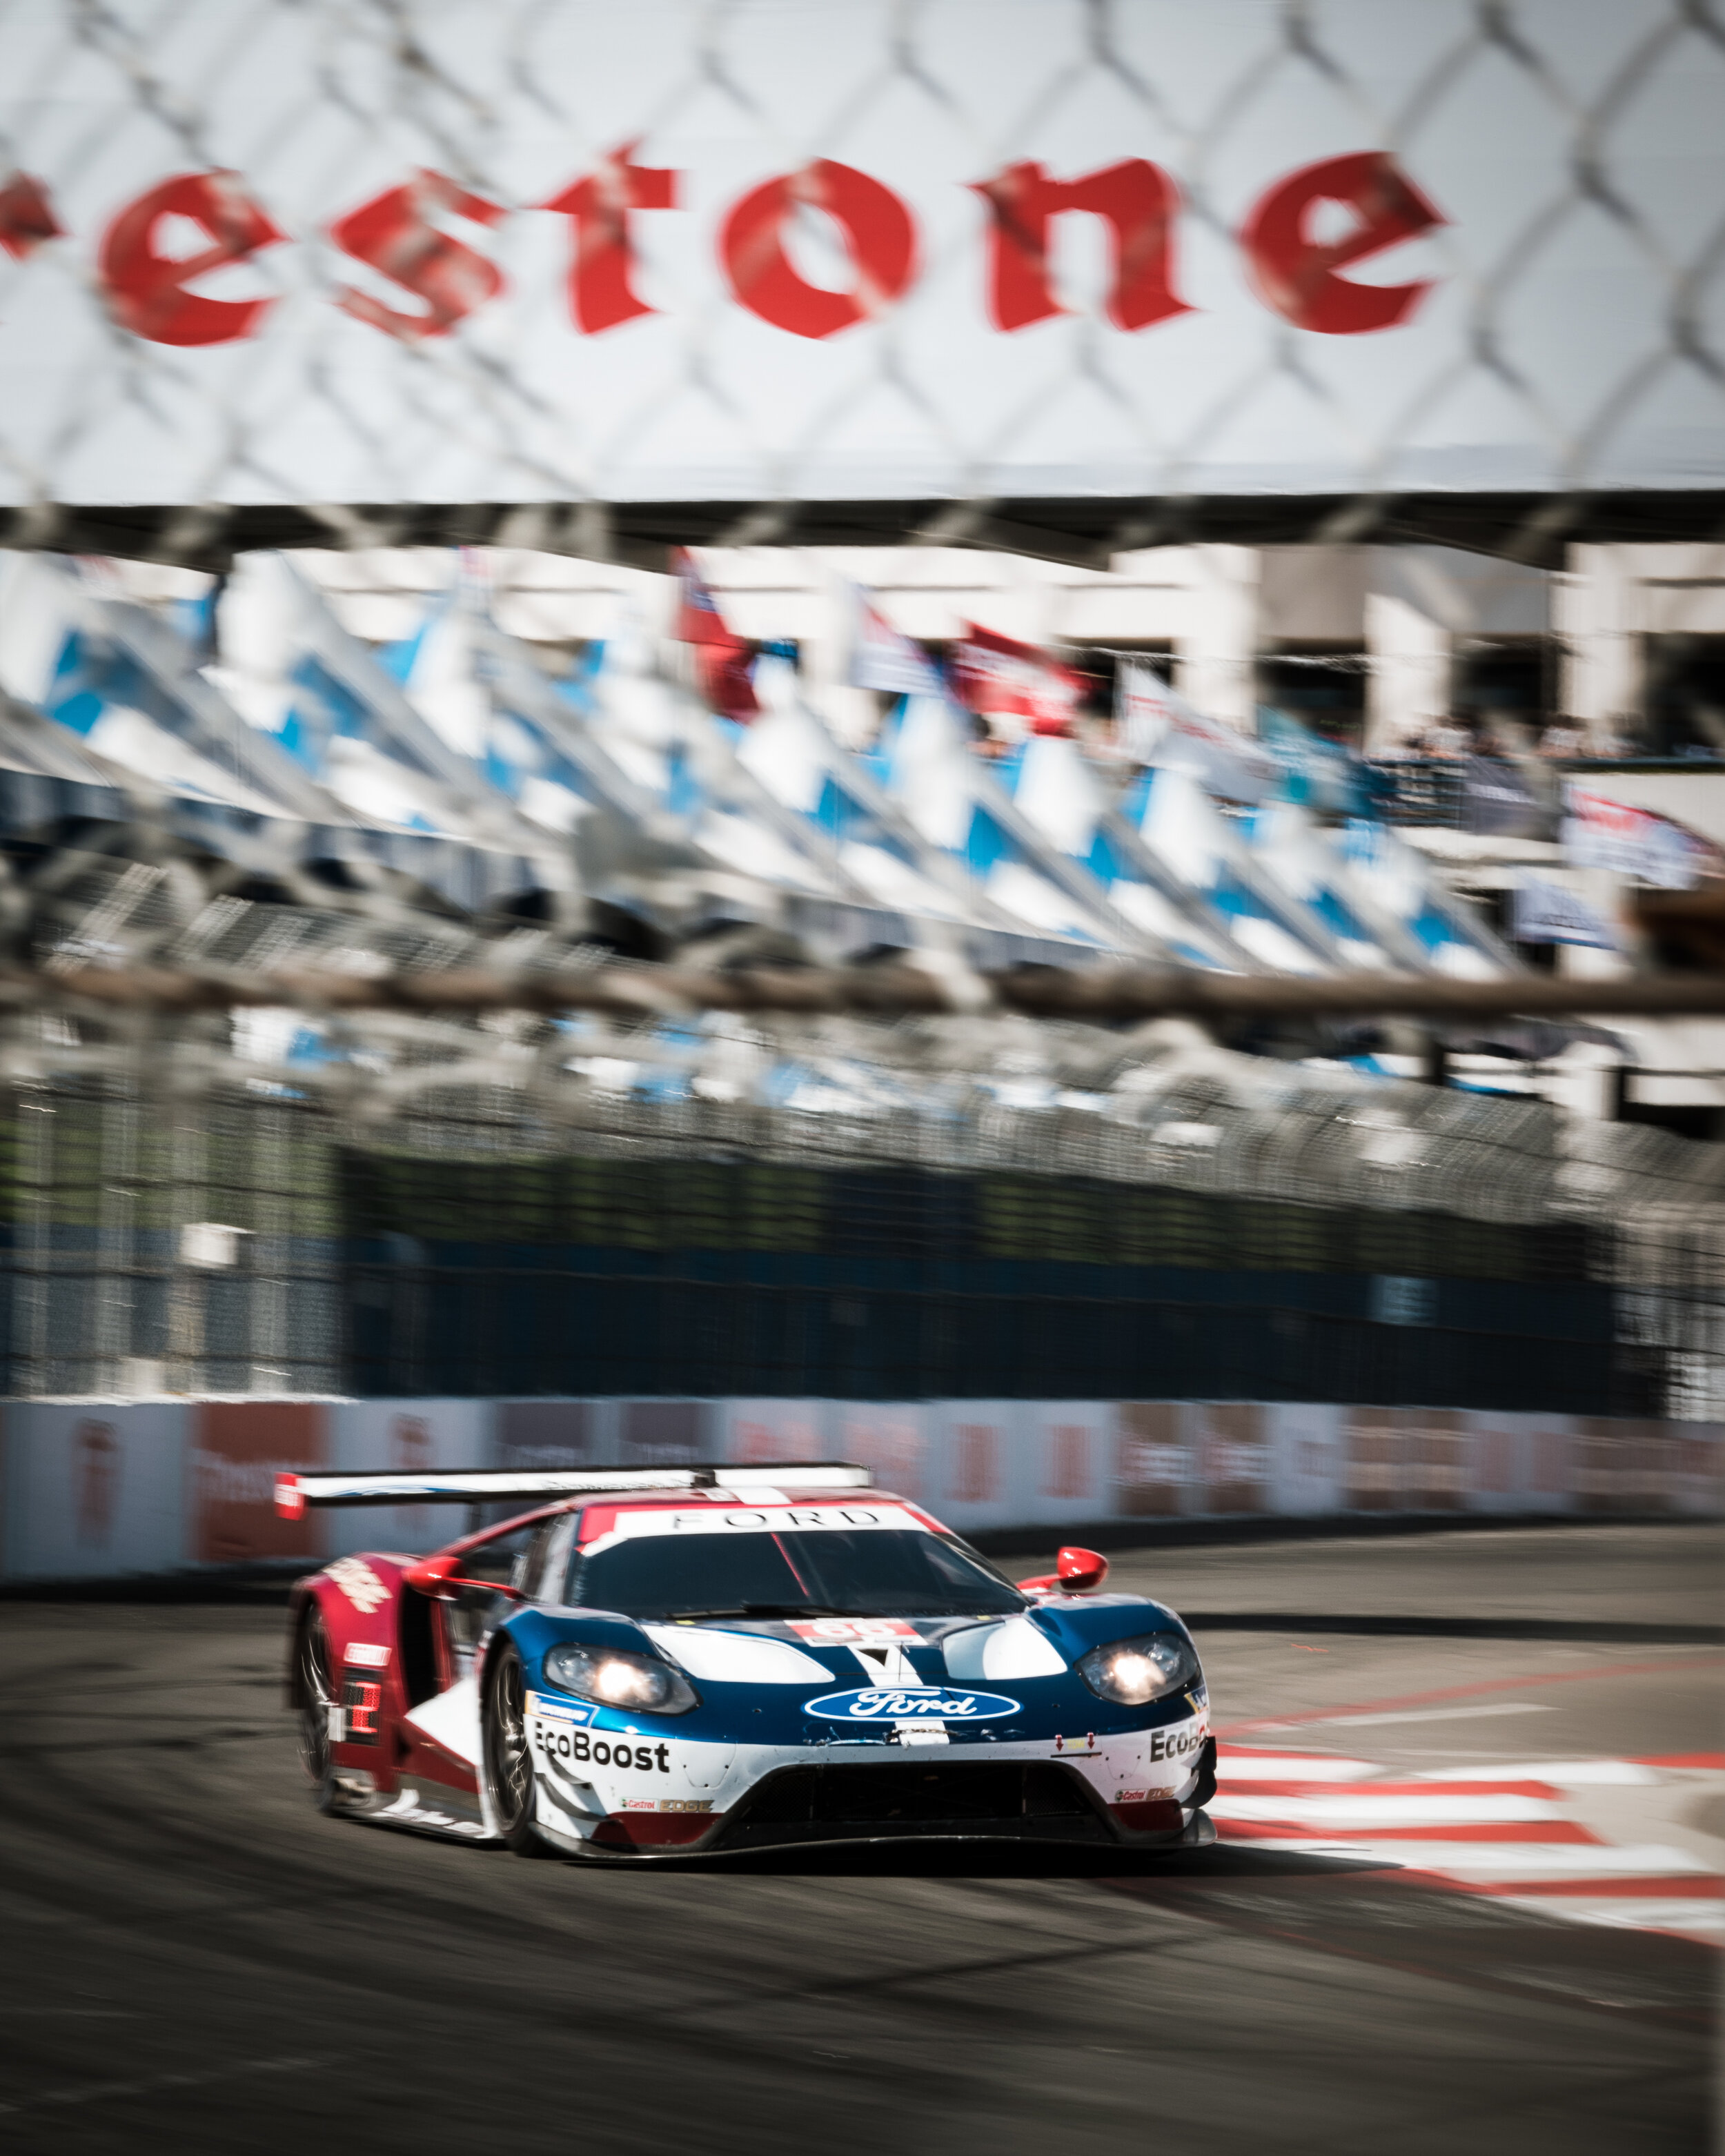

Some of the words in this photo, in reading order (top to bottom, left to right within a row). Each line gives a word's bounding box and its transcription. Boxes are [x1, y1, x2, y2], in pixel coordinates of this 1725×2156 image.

[673, 1510, 880, 1530] FORD
[811, 1622, 897, 1638] 66
[849, 1689, 978, 1717] Ford
[534, 1721, 671, 1774] EcoBoost
[1123, 1790, 1146, 1801] Castrol
[627, 1798, 656, 1810] Castrol
[659, 1799, 716, 1812] EDGE
